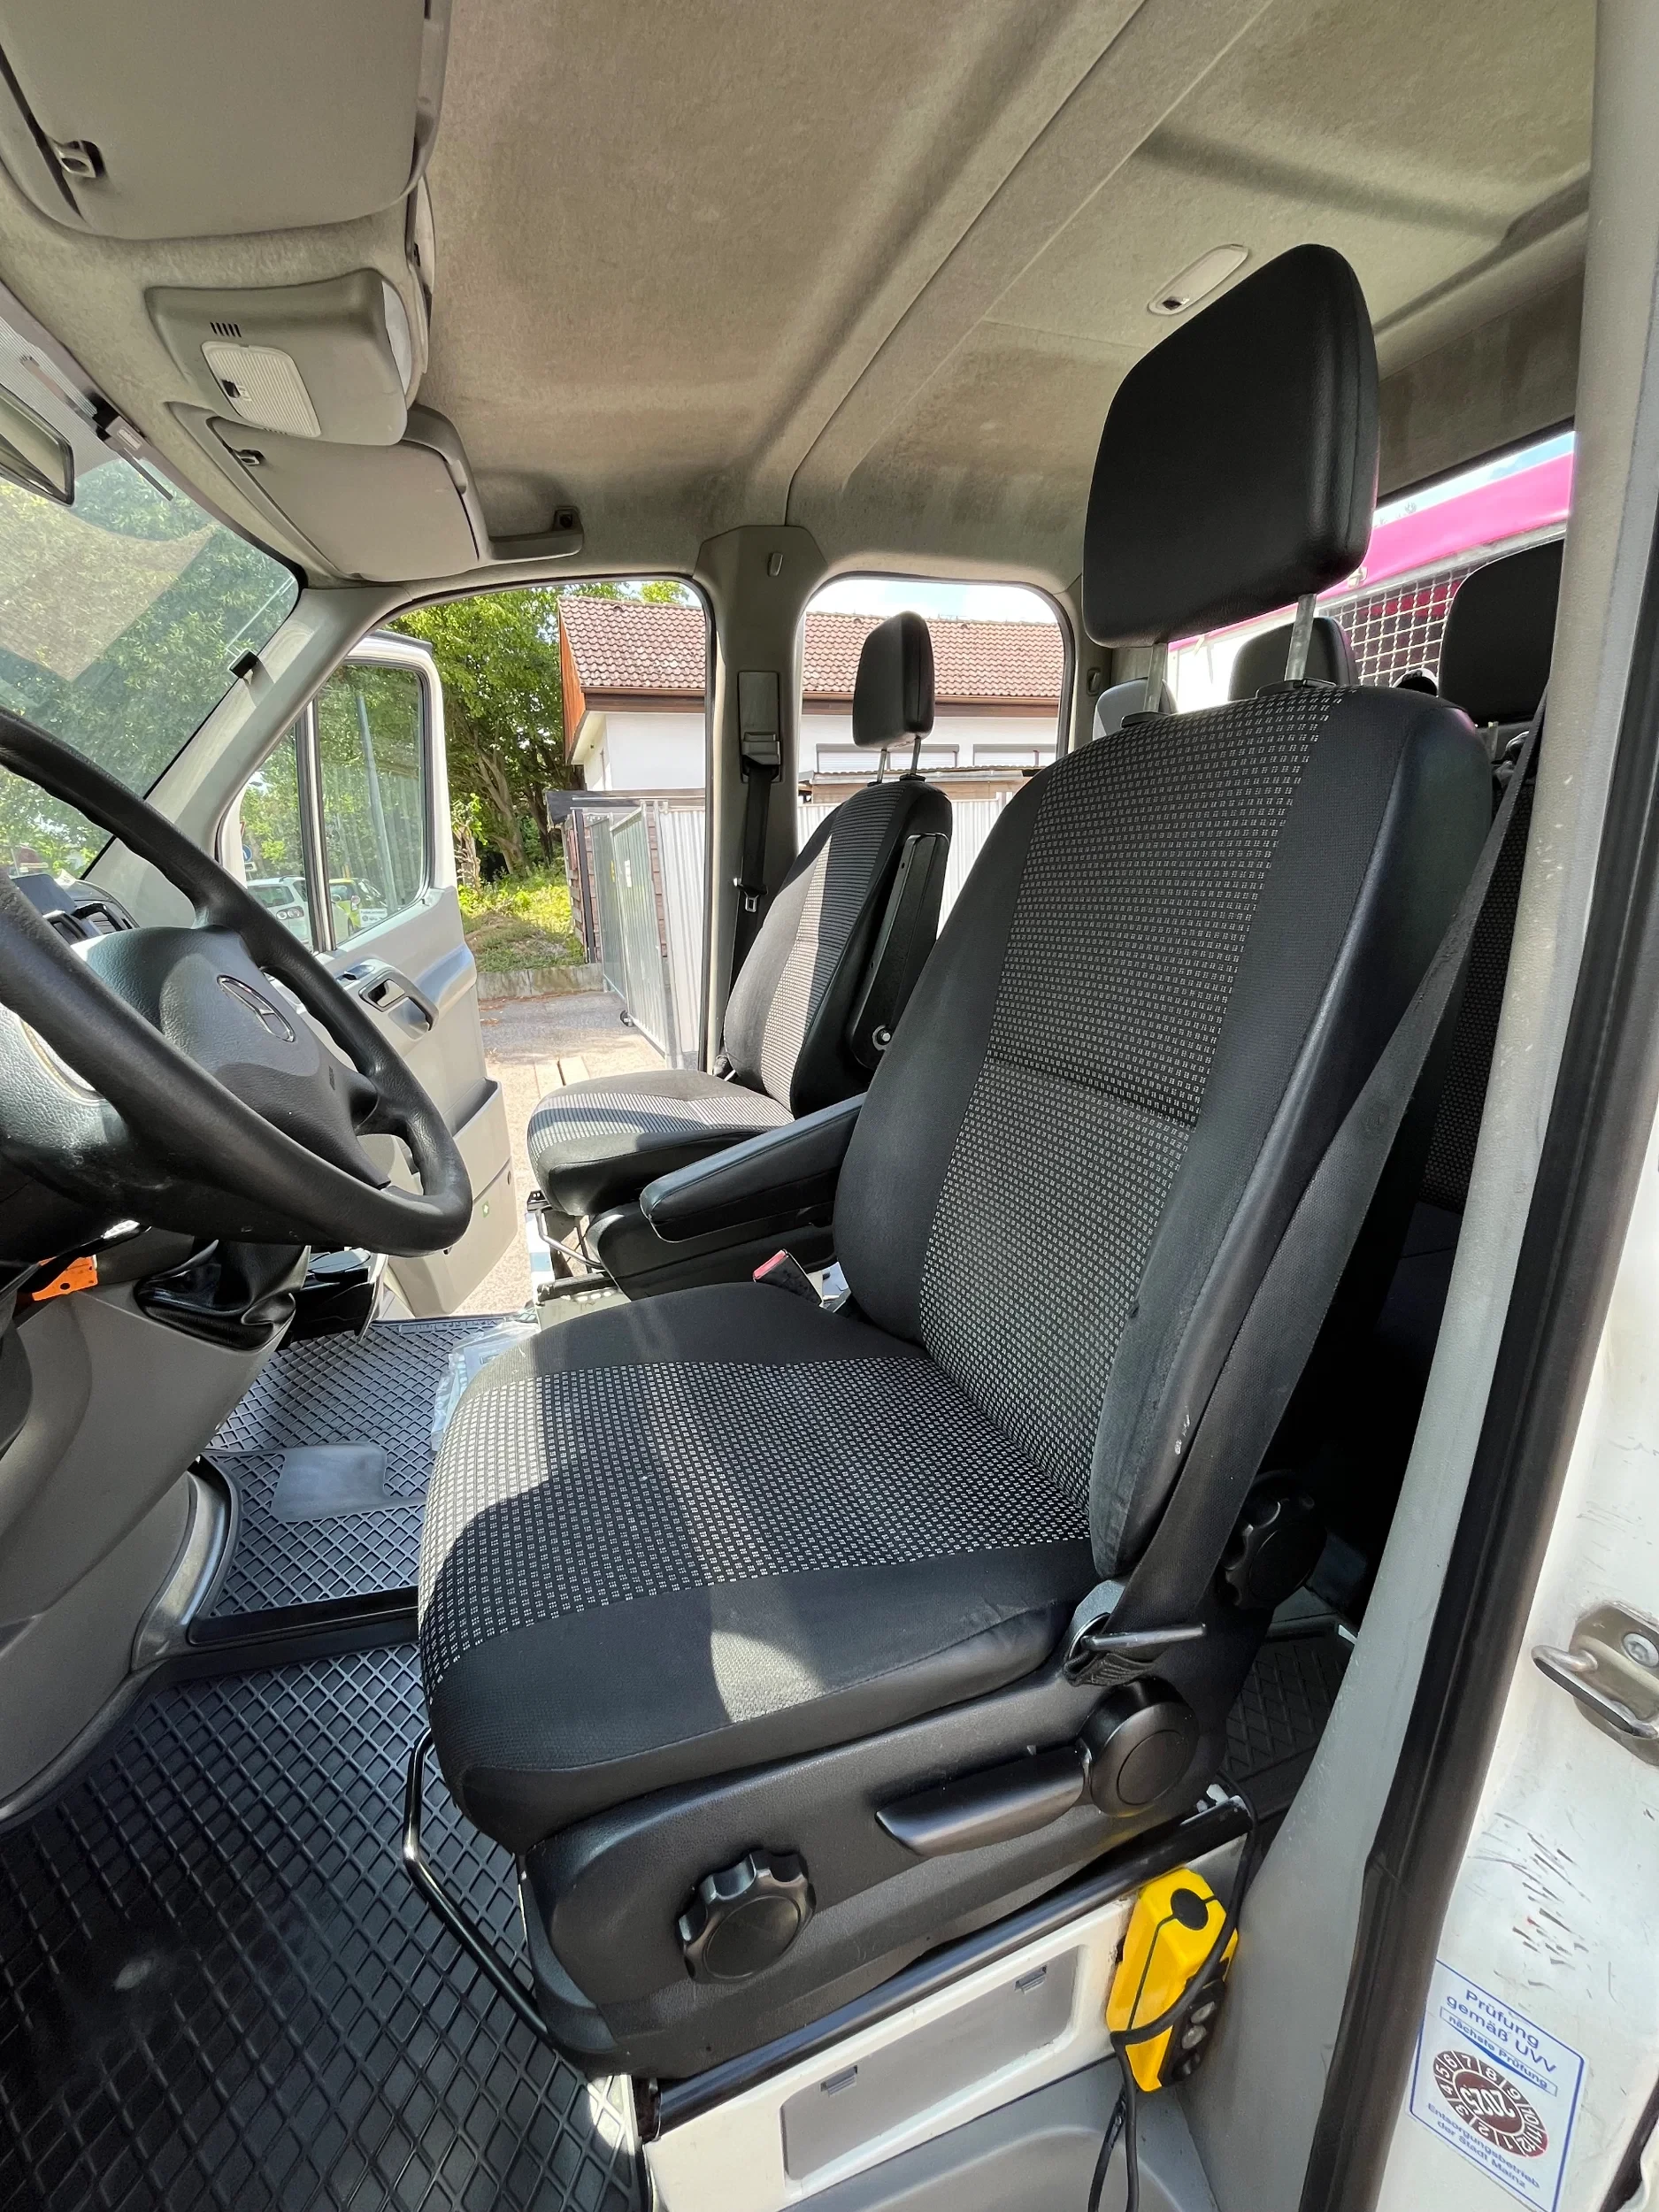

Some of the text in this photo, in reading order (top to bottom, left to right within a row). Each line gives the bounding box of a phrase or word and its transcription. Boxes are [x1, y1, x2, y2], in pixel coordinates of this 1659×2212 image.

[1447, 1996, 1508, 2041] gemäß
[1465, 1990, 1539, 2048] Prüfung
[1449, 2016, 1548, 2088] nächste Prüfung
[1443, 2054, 1458, 2069] 6
[1462, 2055, 1471, 2069] 7
[1436, 2064, 1449, 2078] 5
[1486, 2068, 1497, 2081] 8
[1440, 2084, 1453, 2095] 4
[1507, 2088, 1520, 2101] 9
[1460, 2086, 1516, 2118] 2025
[1455, 2104, 1469, 2116] 3
[1521, 2108, 1540, 2125] 10
[1479, 2122, 1489, 2137] 2
[1428, 2102, 1540, 2189] Entsorgungsbetrieb
[1517, 2137, 1536, 2152] 12
[1437, 2120, 1526, 2190] der Stadt Mainz
